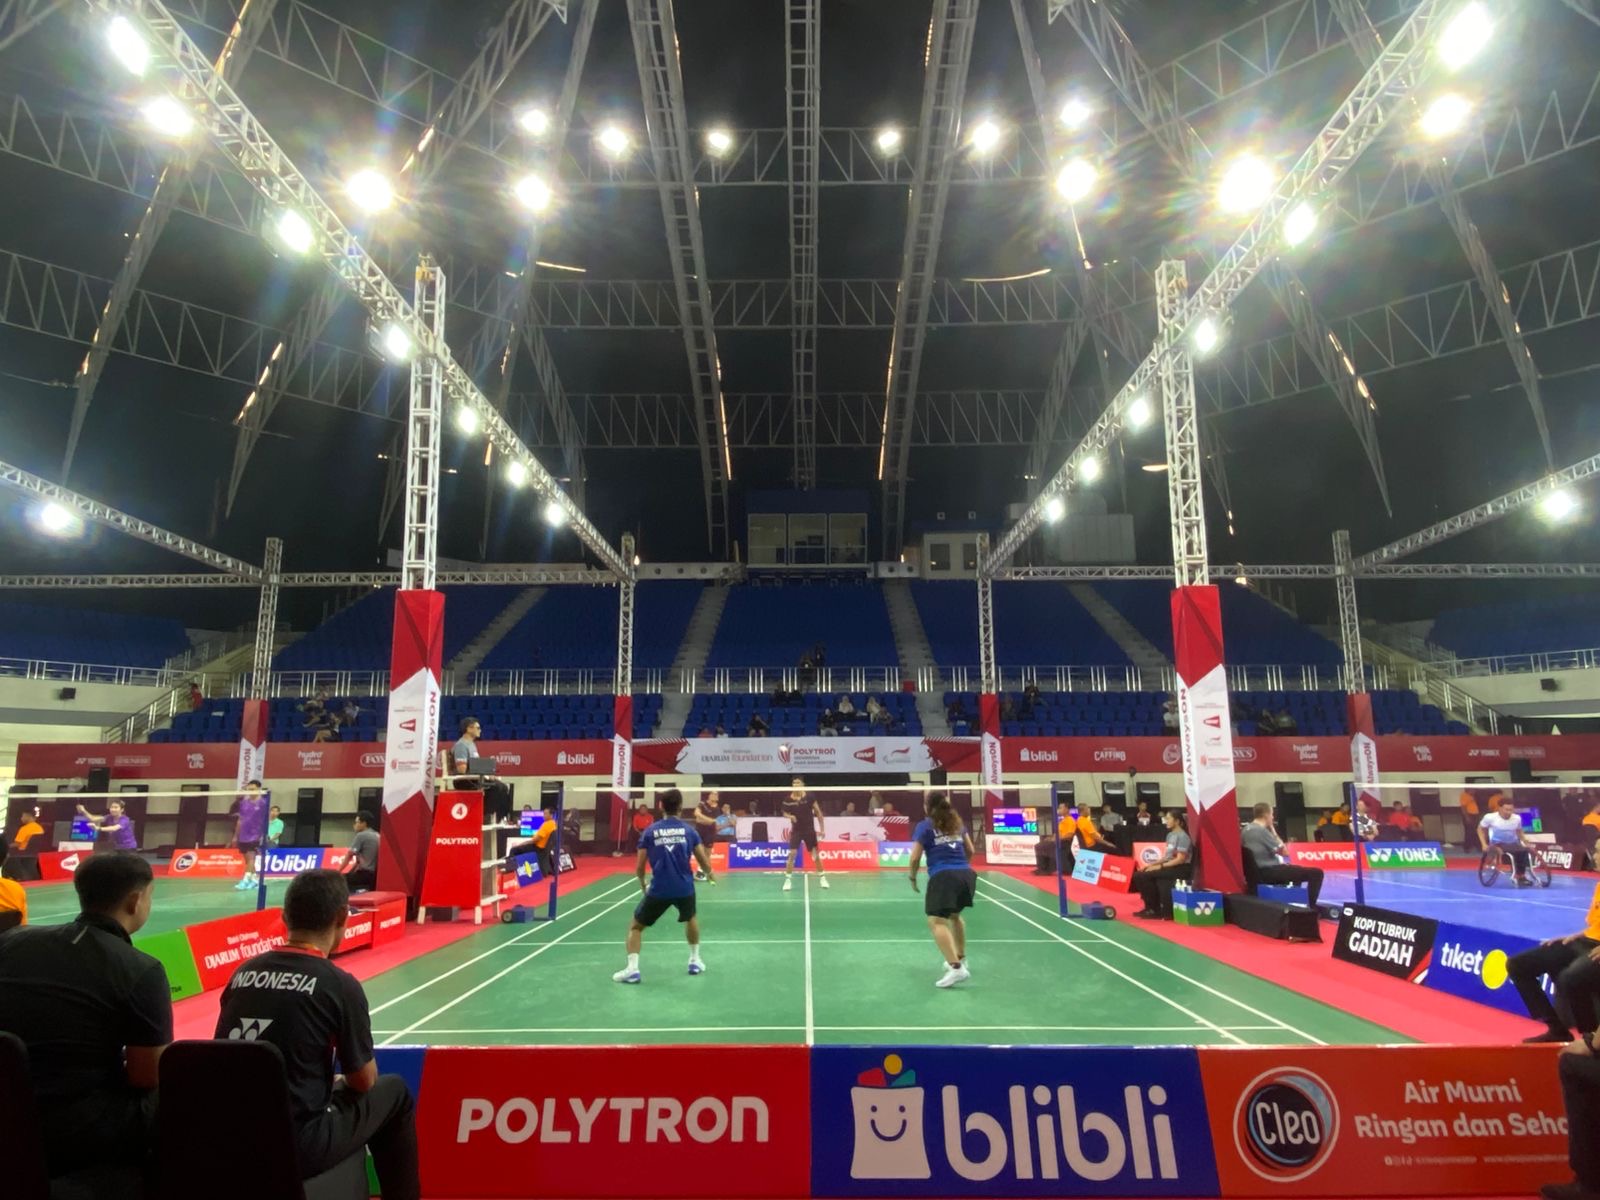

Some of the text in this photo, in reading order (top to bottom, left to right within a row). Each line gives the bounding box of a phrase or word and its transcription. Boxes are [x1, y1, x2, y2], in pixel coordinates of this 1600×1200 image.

[567, 753, 594, 765] blibli
[1030, 750, 1058, 761] blibli
[456, 807, 463, 816] 4
[436, 837, 479, 846] POLYTRON
[737, 846, 791, 860] hydroplu
[812, 850, 872, 860] OLYTRON
[1395, 847, 1441, 862] YONEX
[271, 854, 317, 872] blibli
[344, 921, 372, 939] OLYTRON
[1353, 916, 1418, 943] KOPI TUBRUK
[1348, 932, 1414, 967] GADJAH
[231, 970, 318, 996] INDONESIA
[1404, 1078, 1523, 1105] Air Murni
[456, 1096, 770, 1144] POLYTRON
[1254, 1100, 1321, 1146] Cleo
[1354, 1112, 1569, 1145] Ringan dan Seha
[941, 1084, 1179, 1182] blibli
